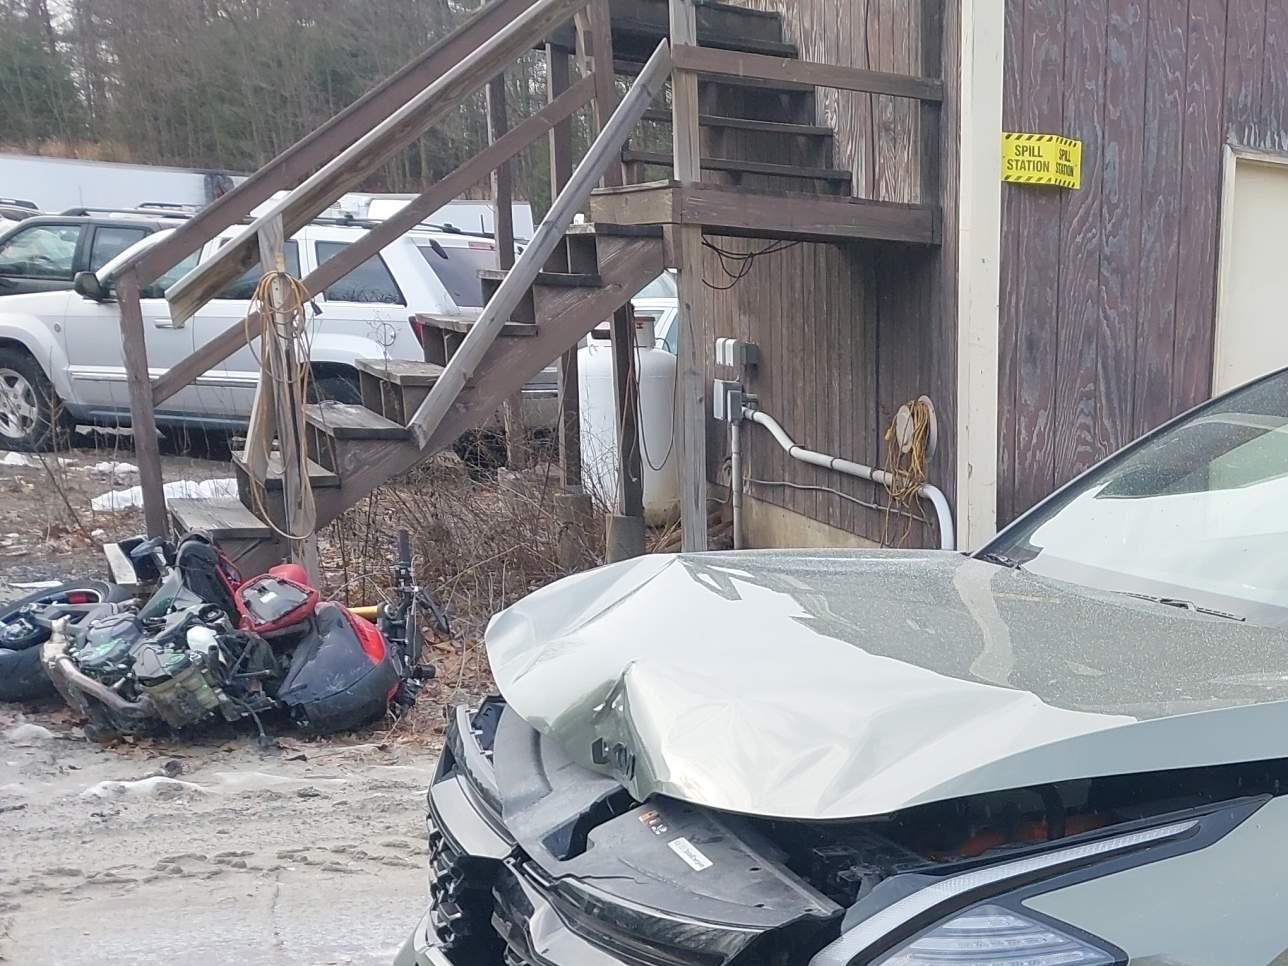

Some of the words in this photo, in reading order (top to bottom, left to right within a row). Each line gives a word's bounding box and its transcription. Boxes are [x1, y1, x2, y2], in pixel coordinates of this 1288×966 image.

[1015, 144, 1043, 157] SPILL
[1059, 149, 1071, 162] SPILL
[1007, 159, 1049, 172] STATION
[1056, 163, 1074, 177] STATION
